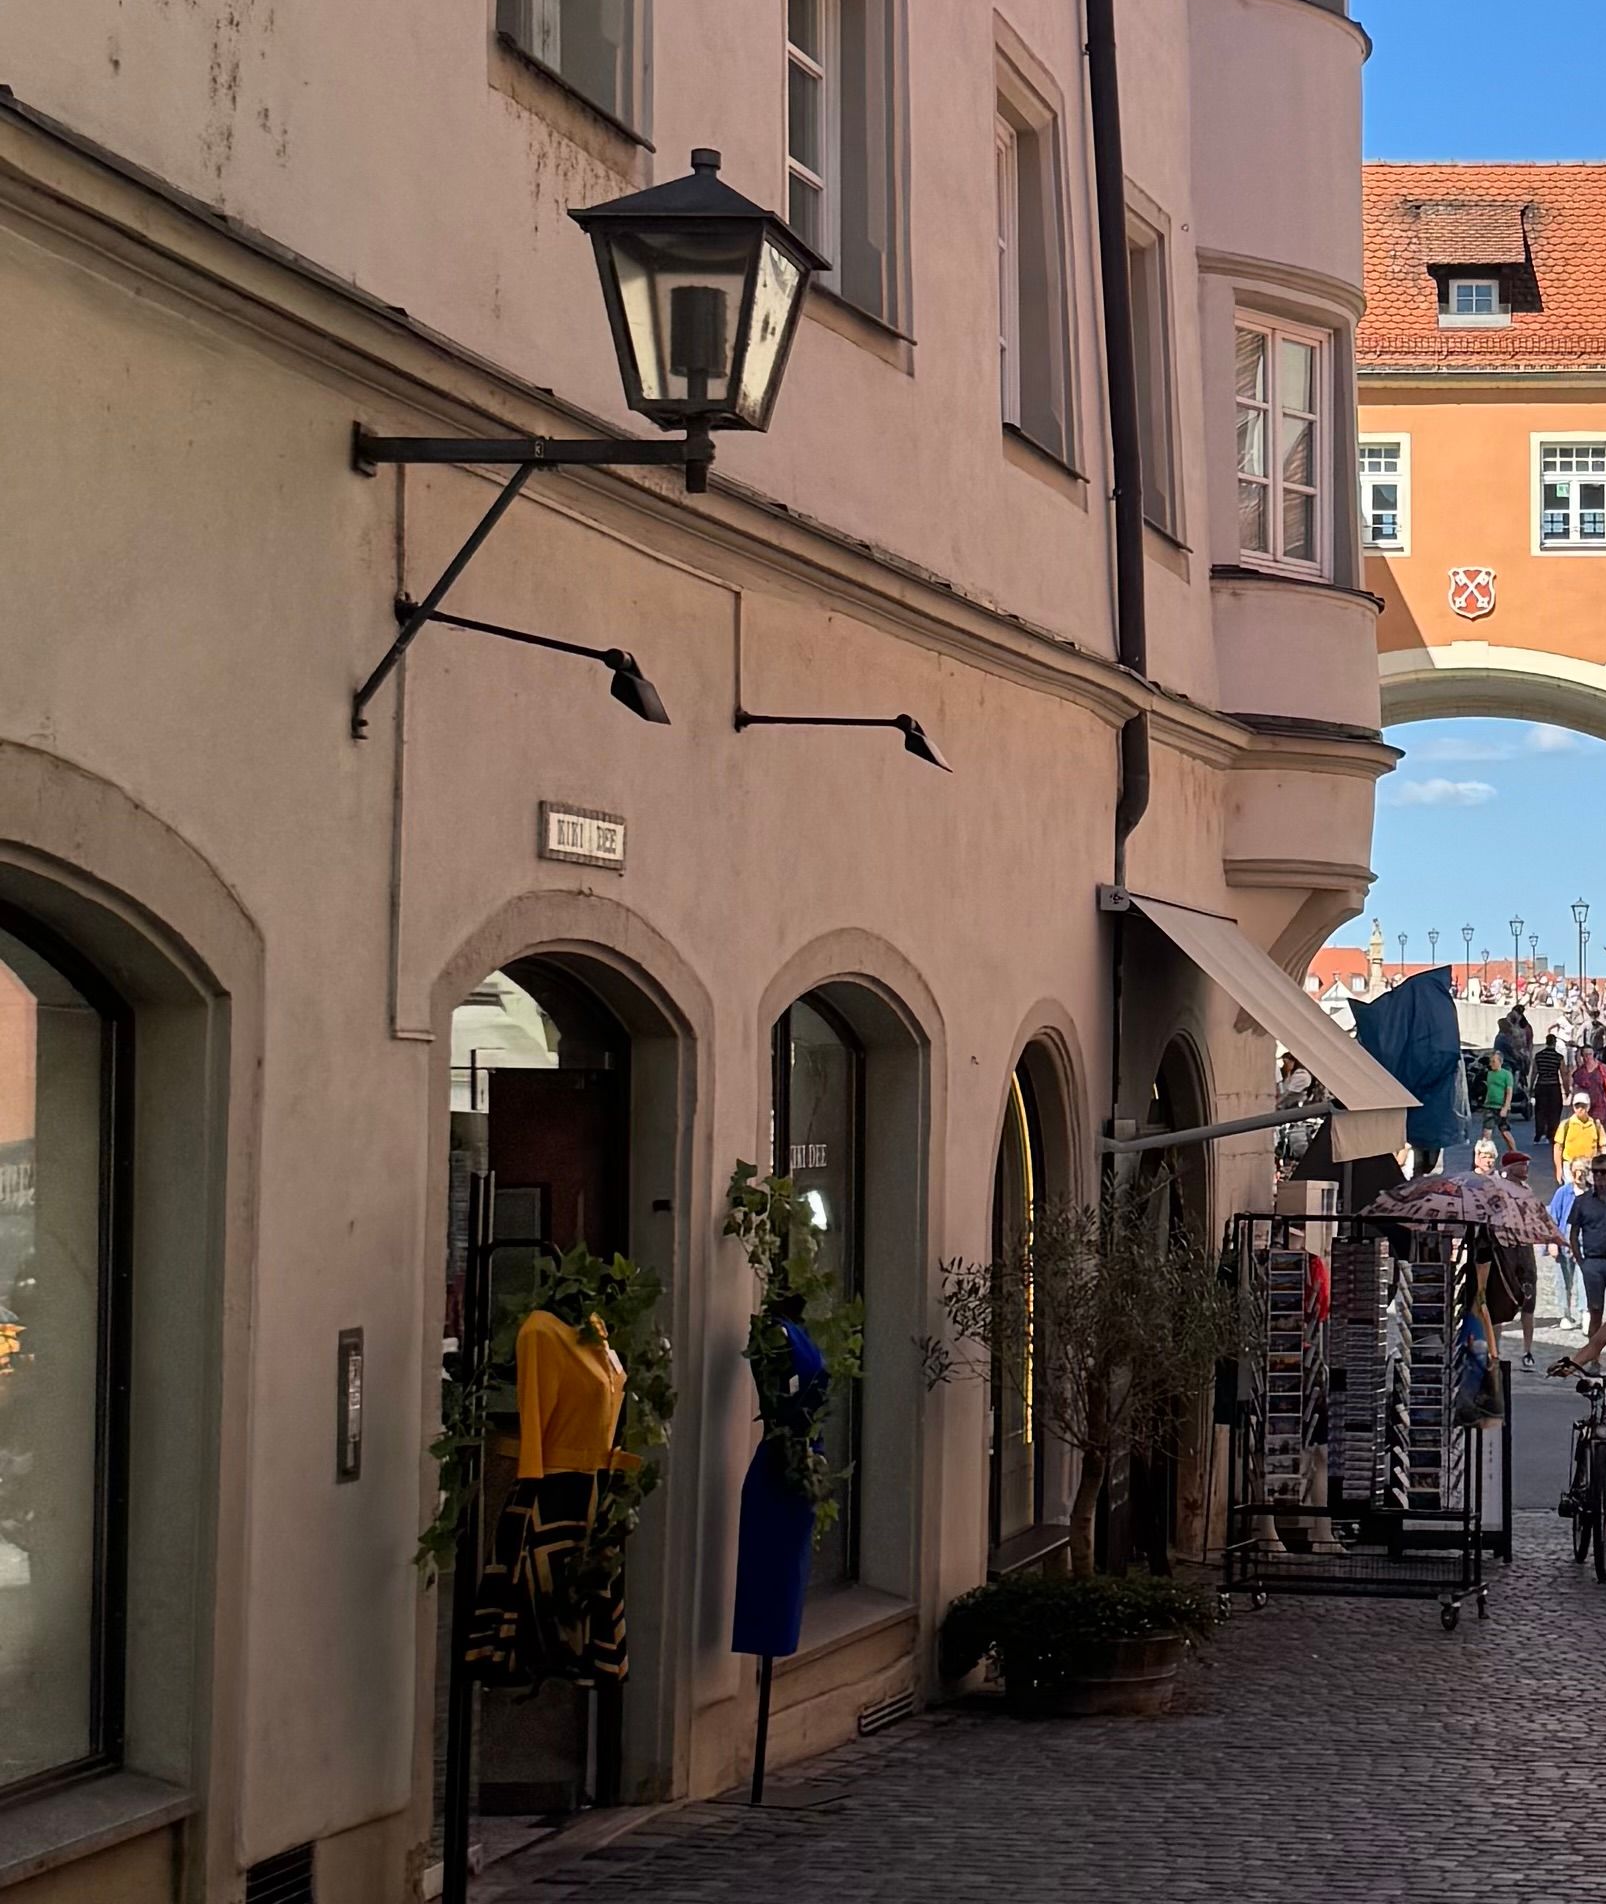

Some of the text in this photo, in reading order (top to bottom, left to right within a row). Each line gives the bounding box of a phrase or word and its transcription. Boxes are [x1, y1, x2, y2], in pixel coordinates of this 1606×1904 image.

[558, 819, 616, 854] KIKI DEE
[809, 1144, 827, 1168] DEE
